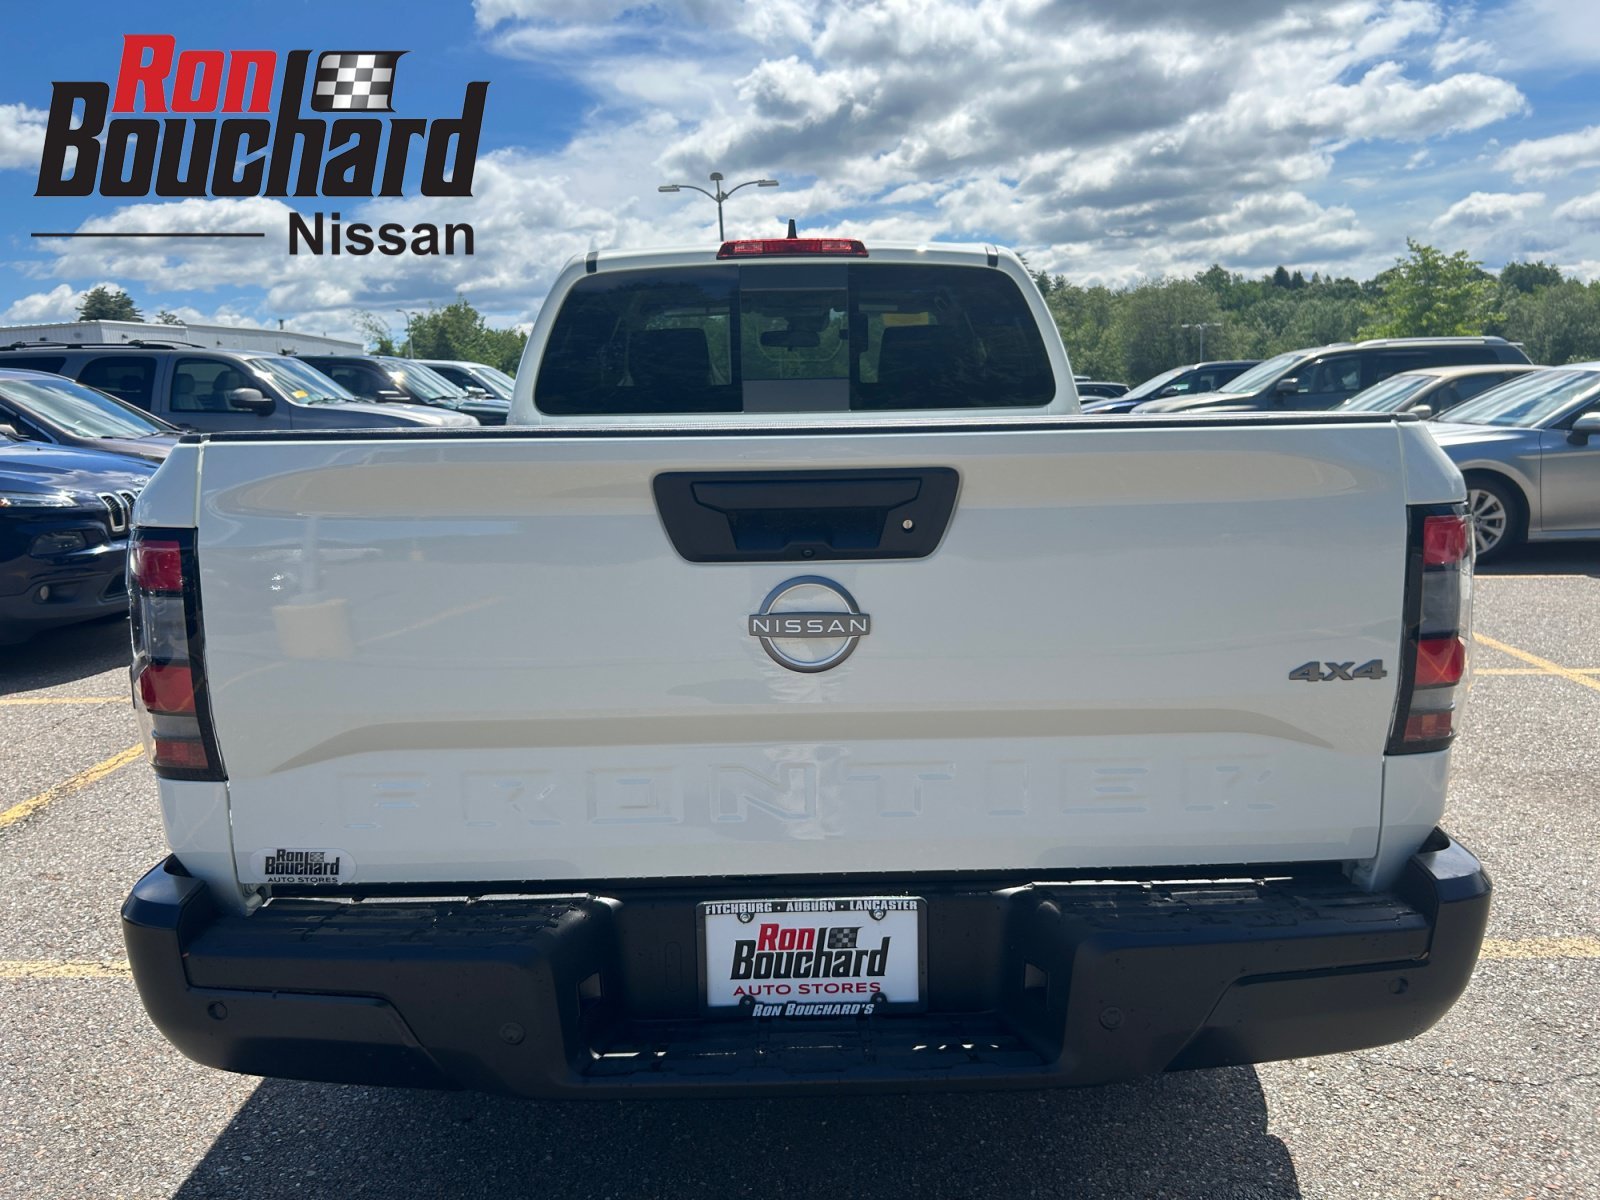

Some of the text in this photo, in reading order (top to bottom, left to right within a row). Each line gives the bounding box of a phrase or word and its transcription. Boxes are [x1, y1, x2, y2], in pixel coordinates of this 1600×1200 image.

[753, 619, 867, 633] NISSAN
[335, 757, 1280, 828] FRONTIER
[265, 852, 340, 875] Bouchard
[276, 849, 304, 862] Ron
[705, 899, 918, 915] FITCHBURG AUBURN LANCASTER
[757, 923, 816, 951] Ron
[730, 927, 892, 980] Bouchard
[733, 982, 881, 997] AUTO STORES
